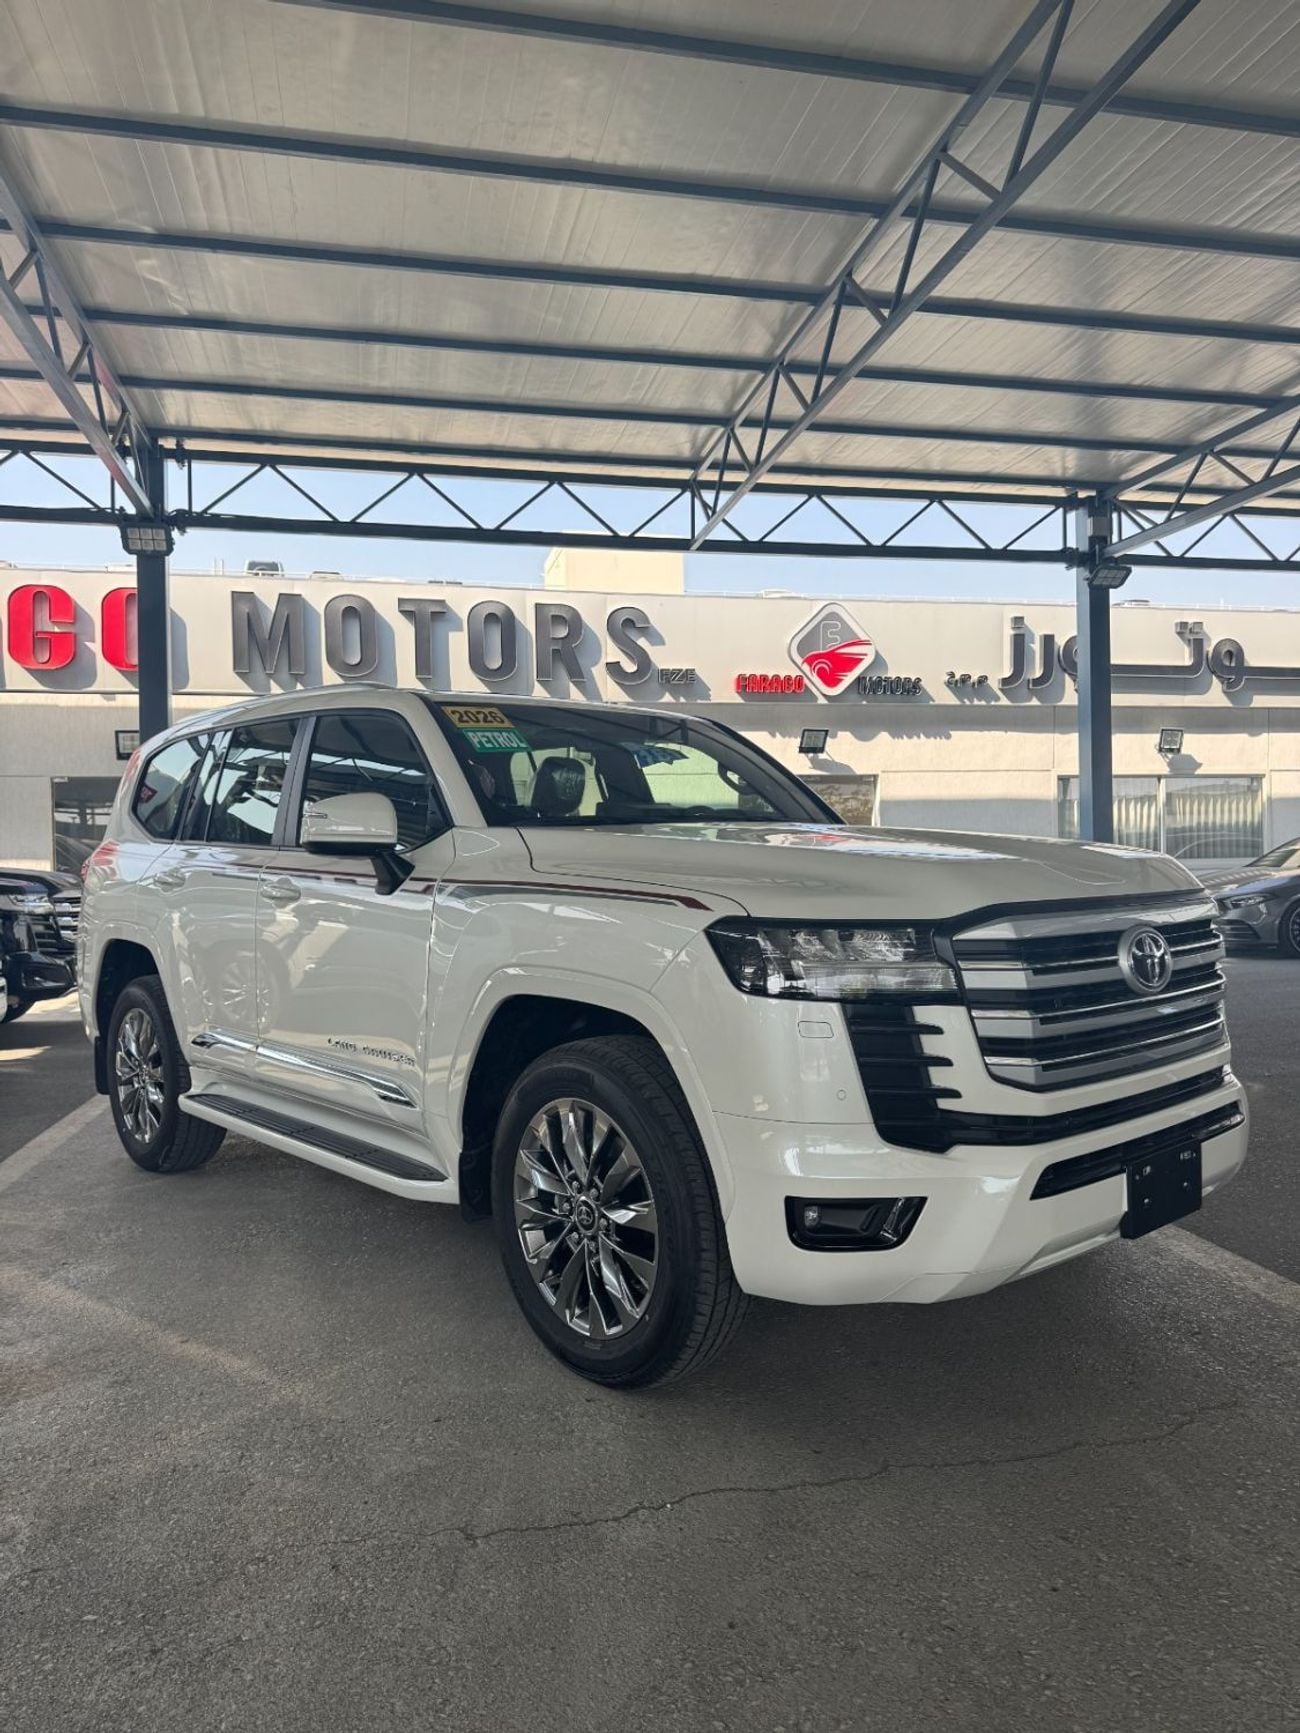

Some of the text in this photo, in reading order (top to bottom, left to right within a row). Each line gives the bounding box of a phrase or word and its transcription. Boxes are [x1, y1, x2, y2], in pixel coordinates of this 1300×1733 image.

[231, 590, 653, 685] MOTORS
[658, 668, 697, 684] FZE
[858, 676, 922, 695] MOTORS
[450, 710, 505, 724] 2026
[465, 731, 529, 748] PETROL
